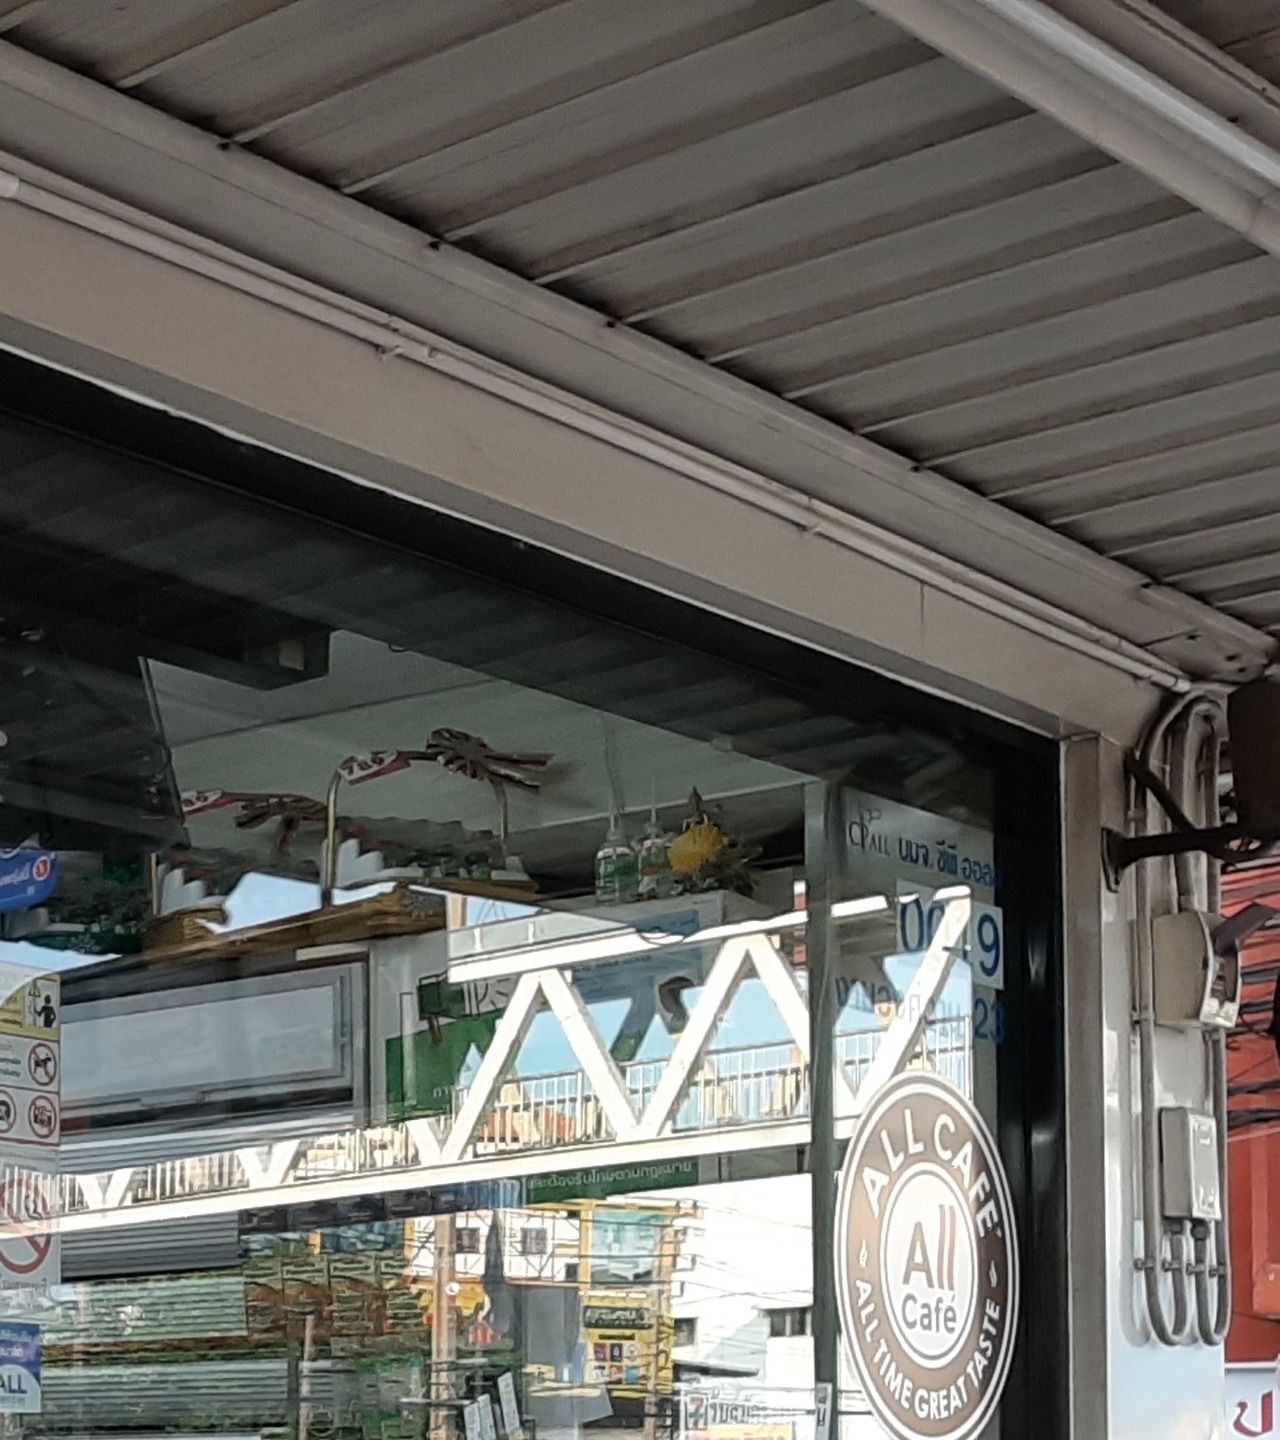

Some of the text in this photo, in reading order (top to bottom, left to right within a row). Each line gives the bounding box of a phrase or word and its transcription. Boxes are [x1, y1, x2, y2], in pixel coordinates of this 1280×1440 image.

[861, 1107, 927, 1219] ALL
[902, 1204, 956, 1291] All
[855, 1279, 1000, 1421] ALL TIME GREAT TASTE
[902, 1292, 957, 1335] Café
